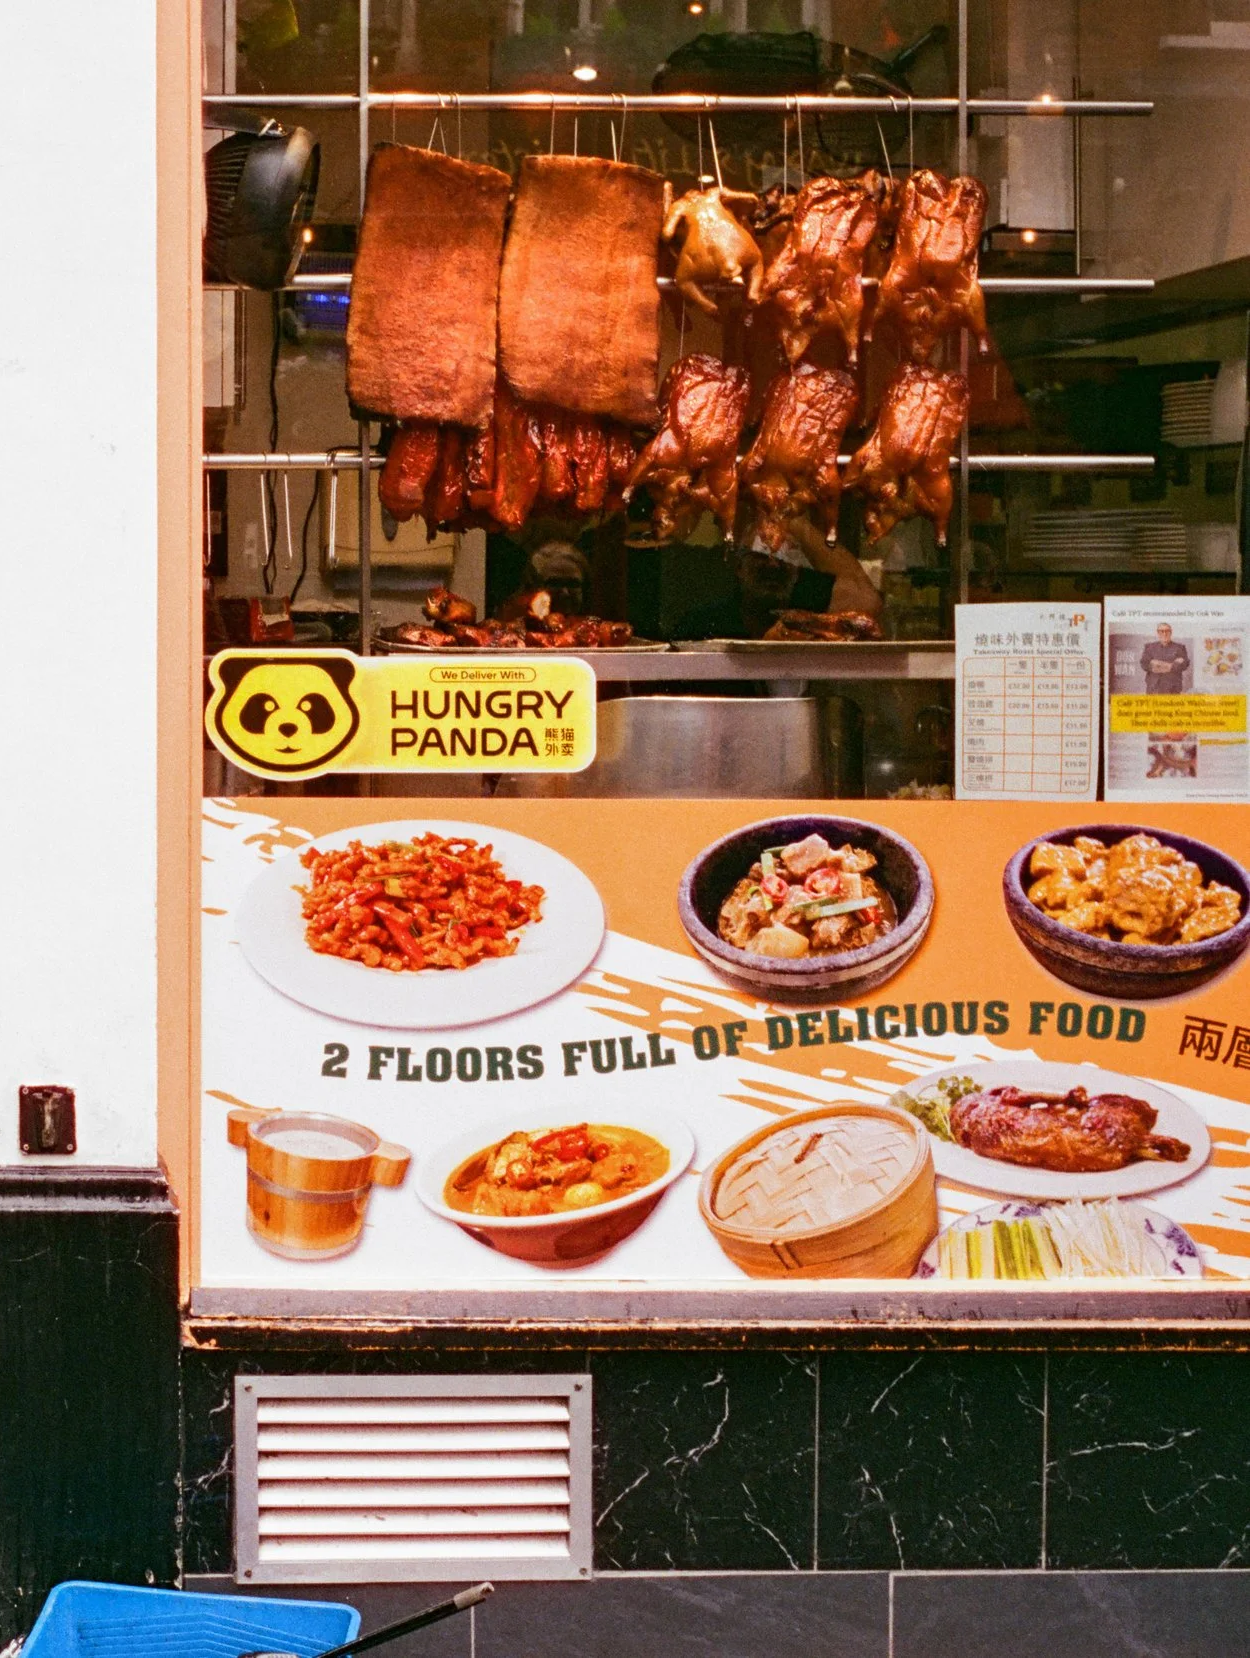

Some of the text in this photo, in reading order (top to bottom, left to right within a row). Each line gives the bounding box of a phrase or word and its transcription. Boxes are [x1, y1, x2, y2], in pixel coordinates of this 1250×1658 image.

[973, 648, 1010, 656] Takeaway
[441, 670, 525, 680] We Deliver With
[391, 690, 574, 719] HUNGRY
[391, 727, 539, 757] PANDA
[545, 727, 575, 742] 熊猫
[545, 743, 575, 757] 外卖
[321, 1000, 1147, 1082] 2 FLOORS FULL OF DELICIOUS FOOD
